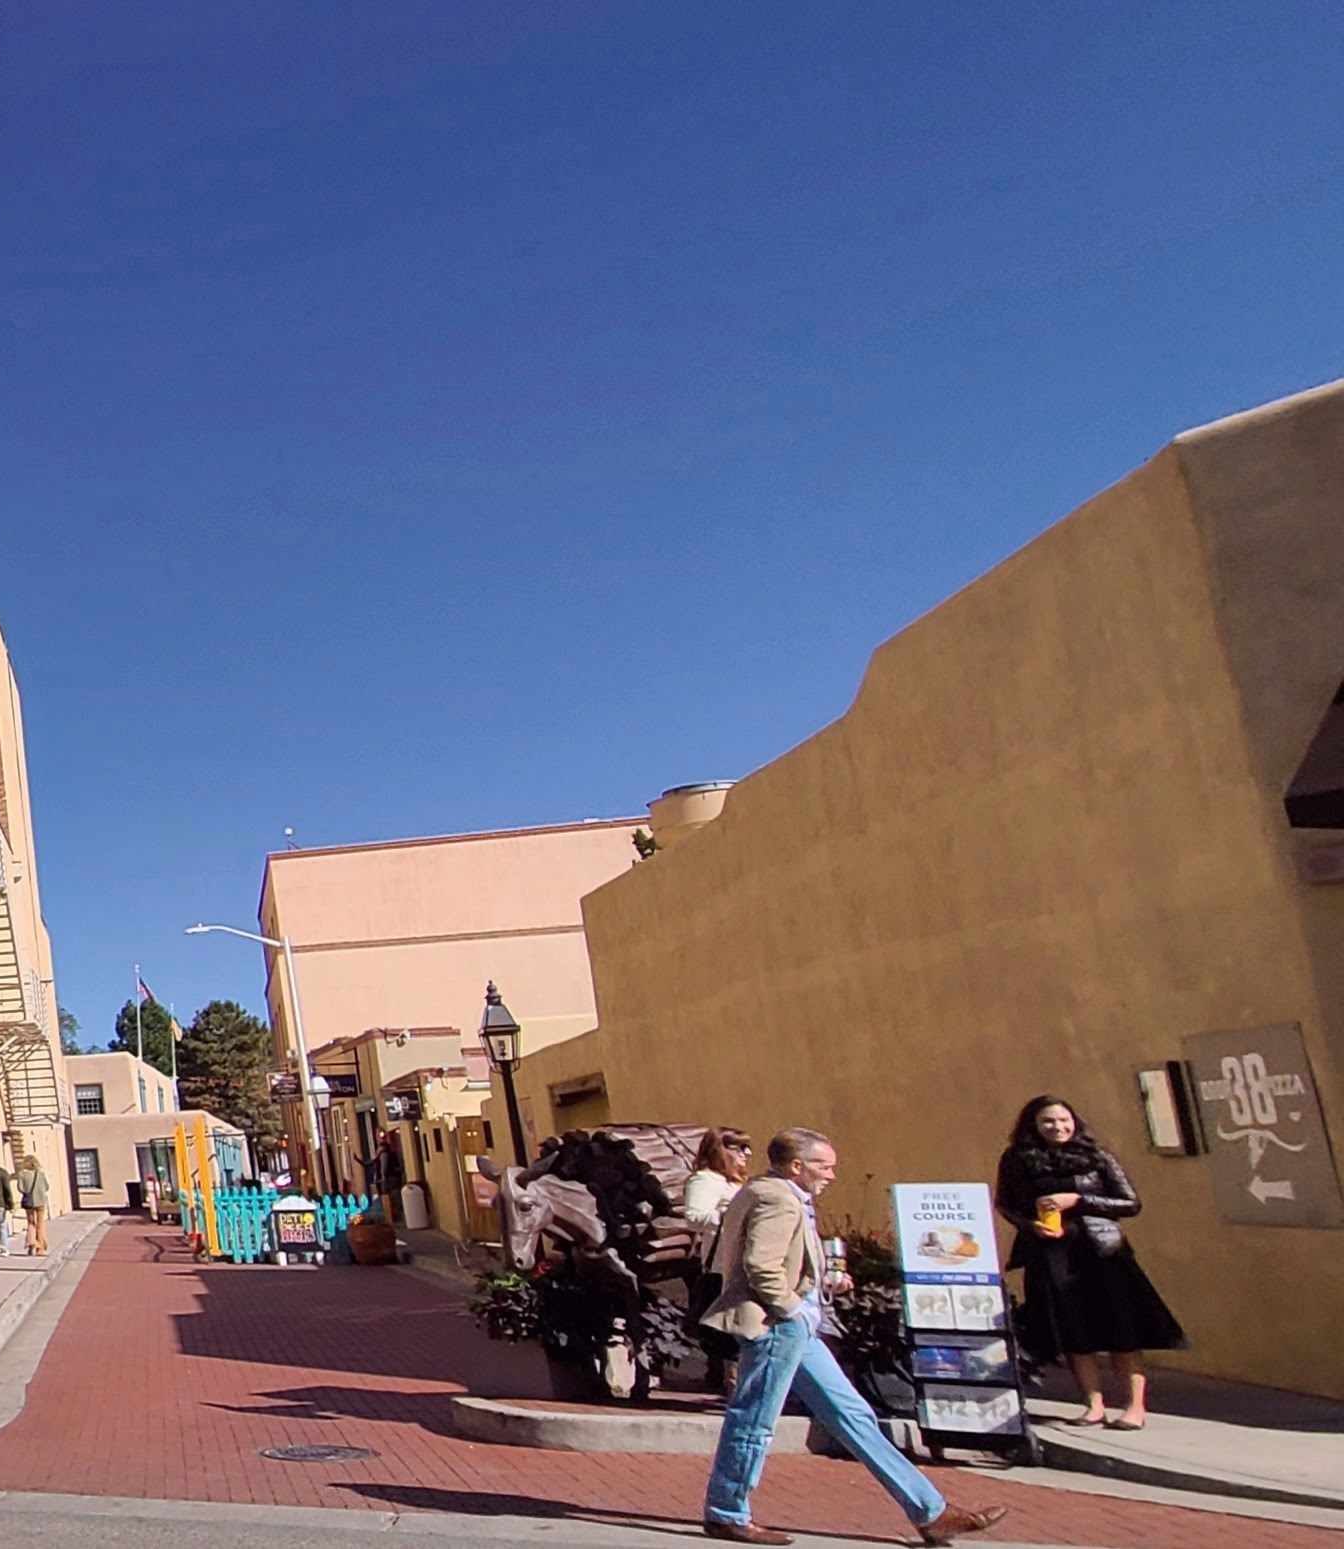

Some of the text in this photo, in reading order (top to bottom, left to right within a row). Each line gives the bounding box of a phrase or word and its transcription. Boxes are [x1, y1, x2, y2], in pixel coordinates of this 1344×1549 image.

[922, 1191, 960, 1201] FREE
[920, 1202, 964, 1211] BIBLE
[912, 1211, 976, 1221] COURSE
